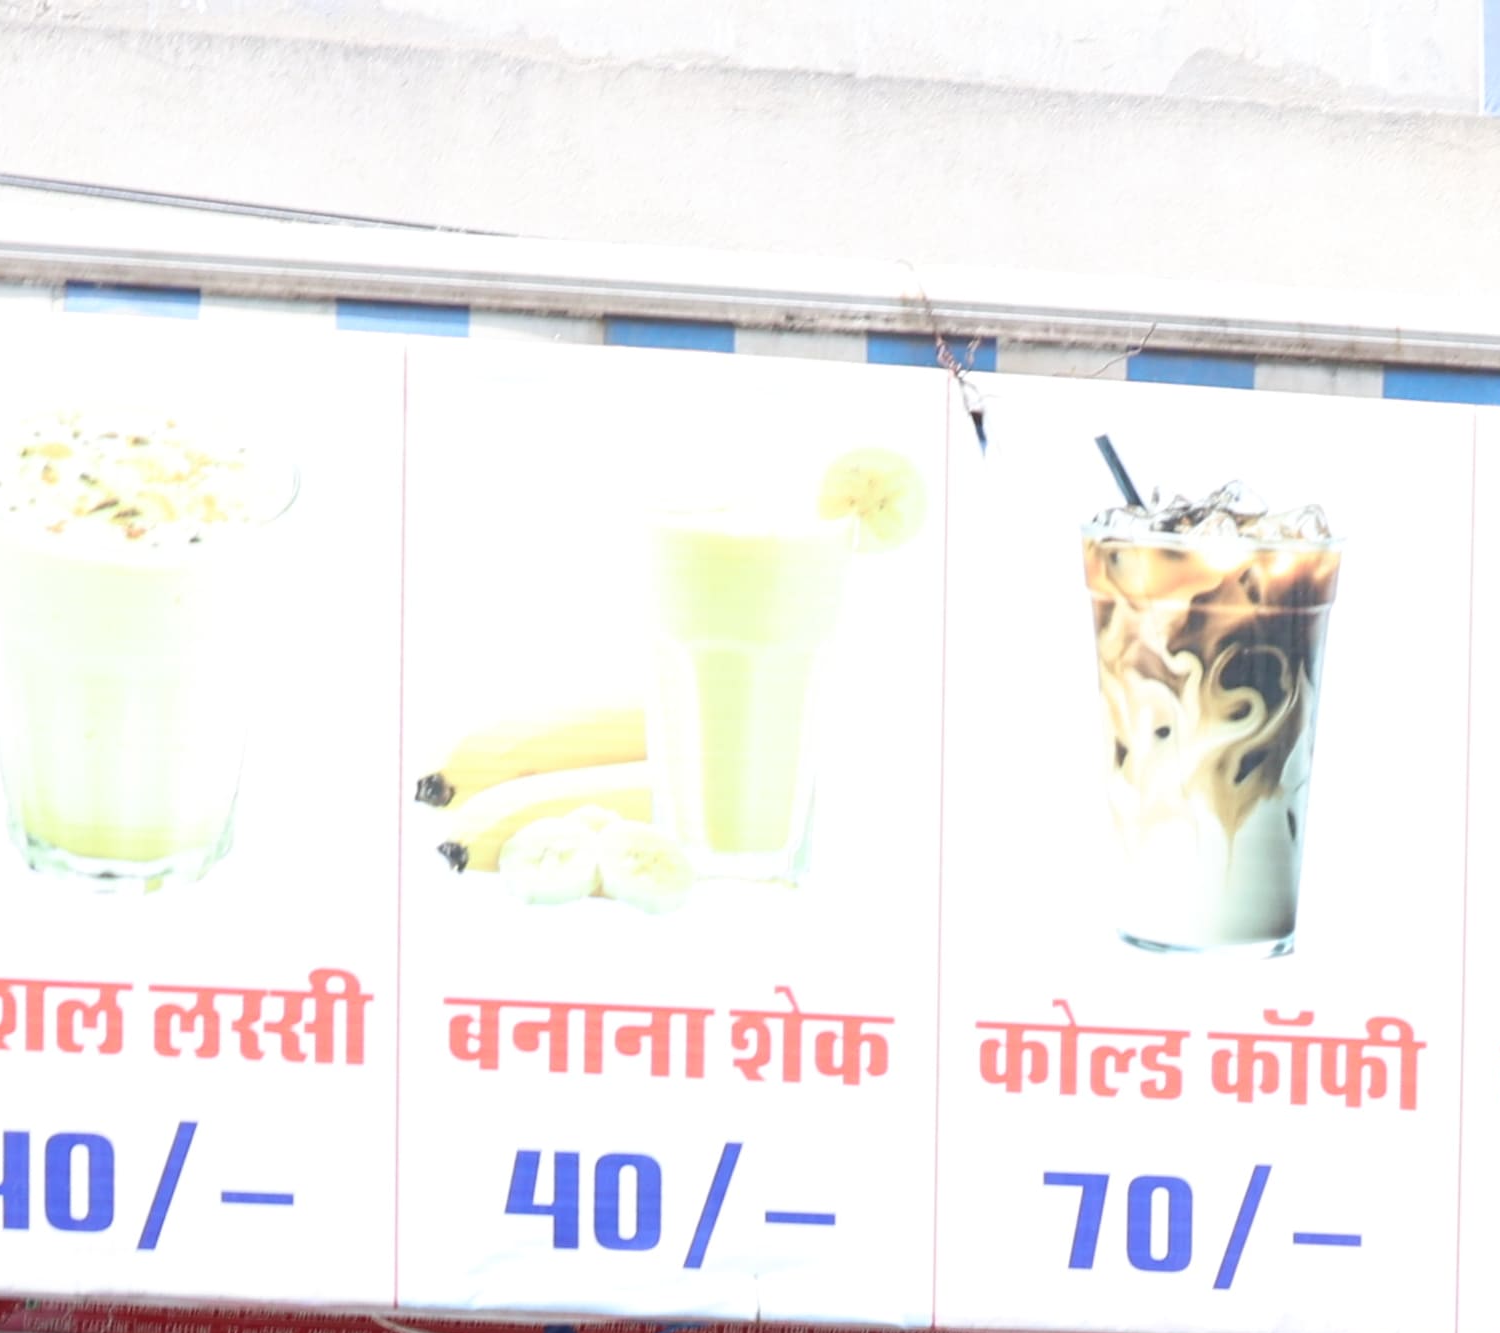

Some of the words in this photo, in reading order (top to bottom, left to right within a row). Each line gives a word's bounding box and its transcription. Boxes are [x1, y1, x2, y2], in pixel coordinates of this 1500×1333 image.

[148, 967, 375, 1066] लस्सी
[443, 996, 715, 1081] बनाना
[729, 985, 896, 1087] शेक
[974, 998, 1191, 1101] कोल्ड
[1206, 1008, 1428, 1112] कॉफी
